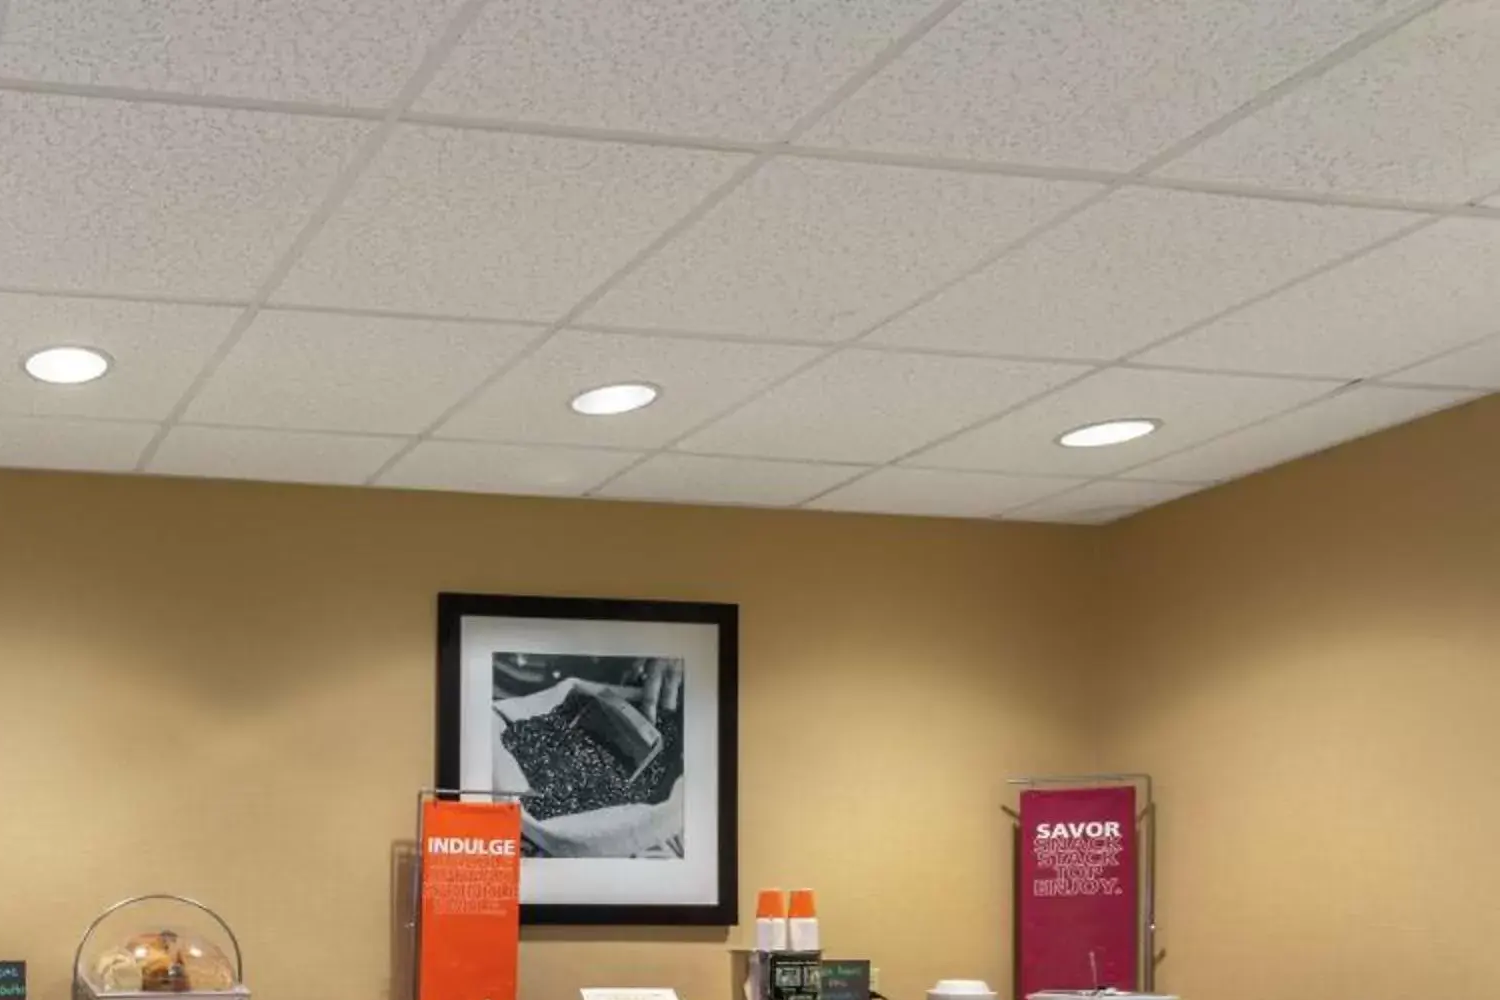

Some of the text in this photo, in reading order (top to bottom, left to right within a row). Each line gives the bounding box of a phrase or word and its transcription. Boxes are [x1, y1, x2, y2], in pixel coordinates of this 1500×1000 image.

[1036, 821, 1120, 839] SAVOR
[427, 837, 516, 856] INDULGE
[1033, 837, 1123, 852] SNACK
[1037, 850, 1120, 867] STACK
[1034, 877, 1123, 896] ENJOY.
